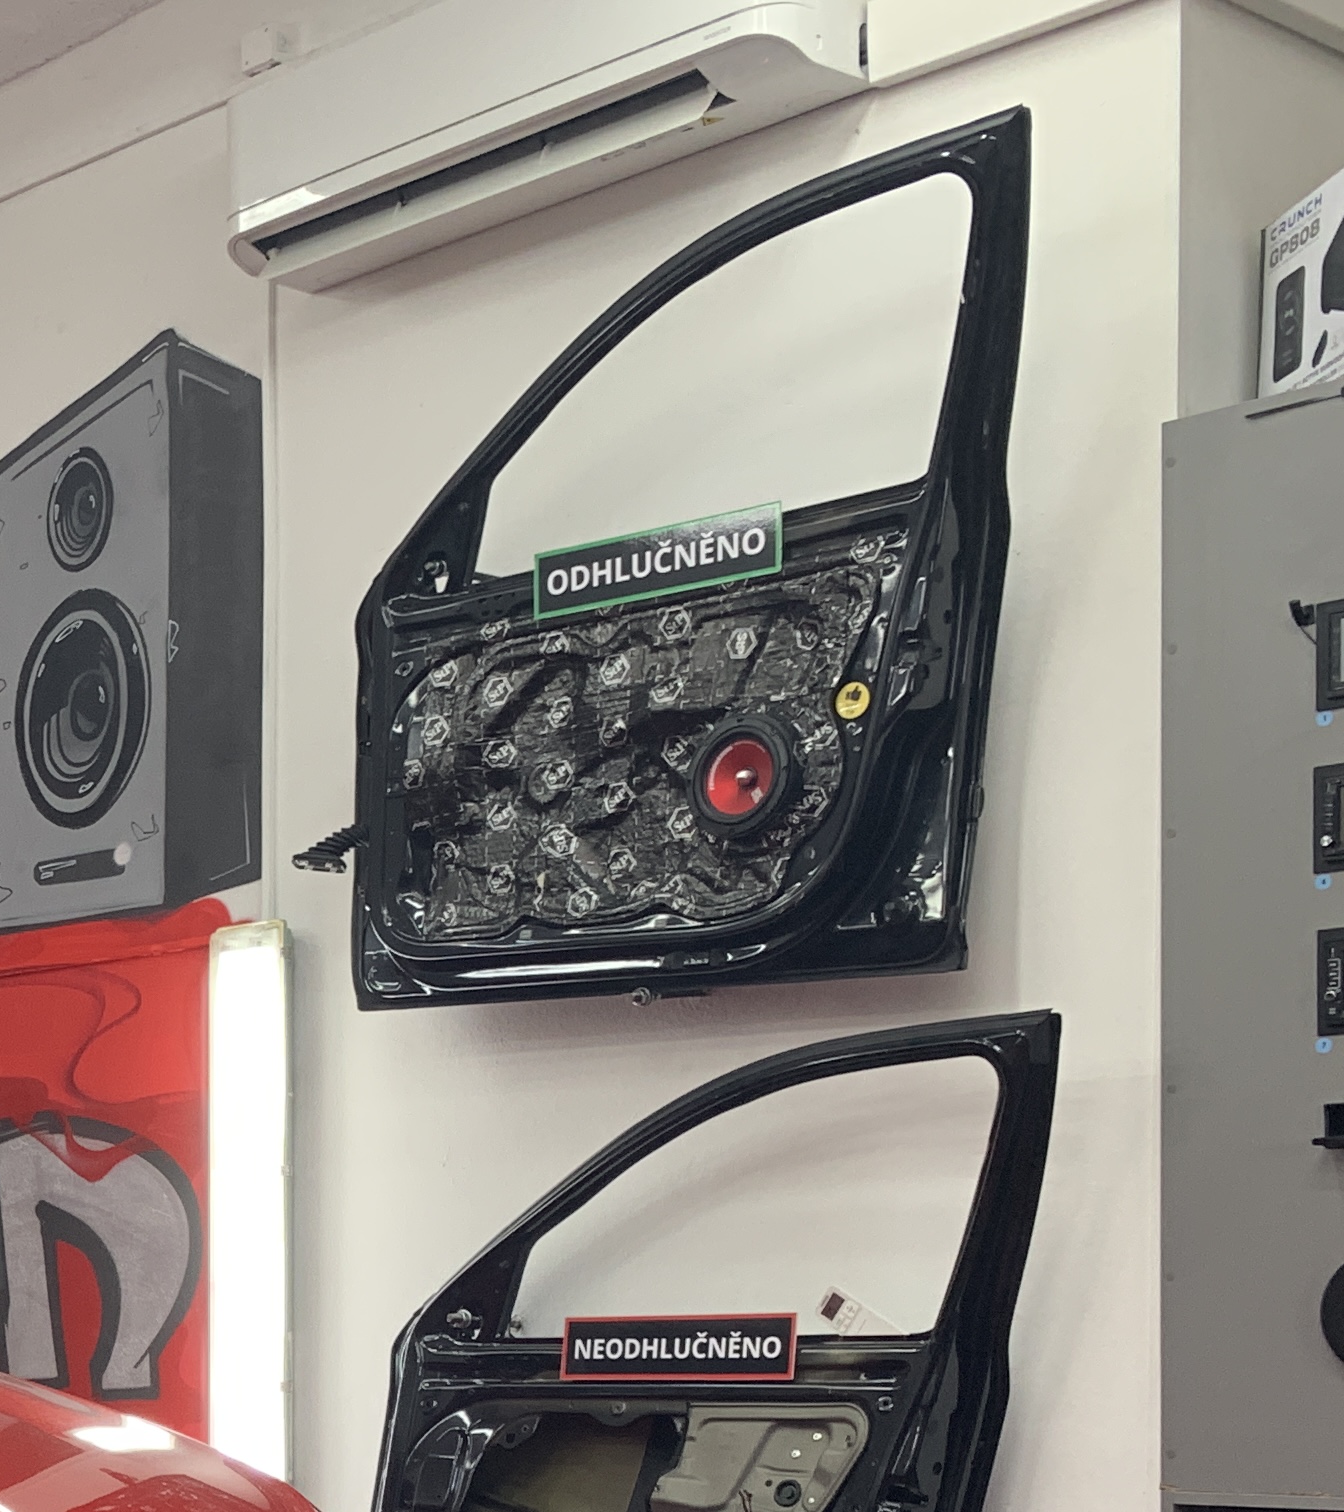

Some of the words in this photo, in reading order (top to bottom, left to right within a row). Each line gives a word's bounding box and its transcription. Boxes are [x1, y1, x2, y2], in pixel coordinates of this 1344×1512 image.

[1270, 192, 1323, 242] CRUNCH
[545, 527, 767, 597] ODHLUČNĚNO
[574, 1331, 782, 1360] NEODHLUČNĚNO
